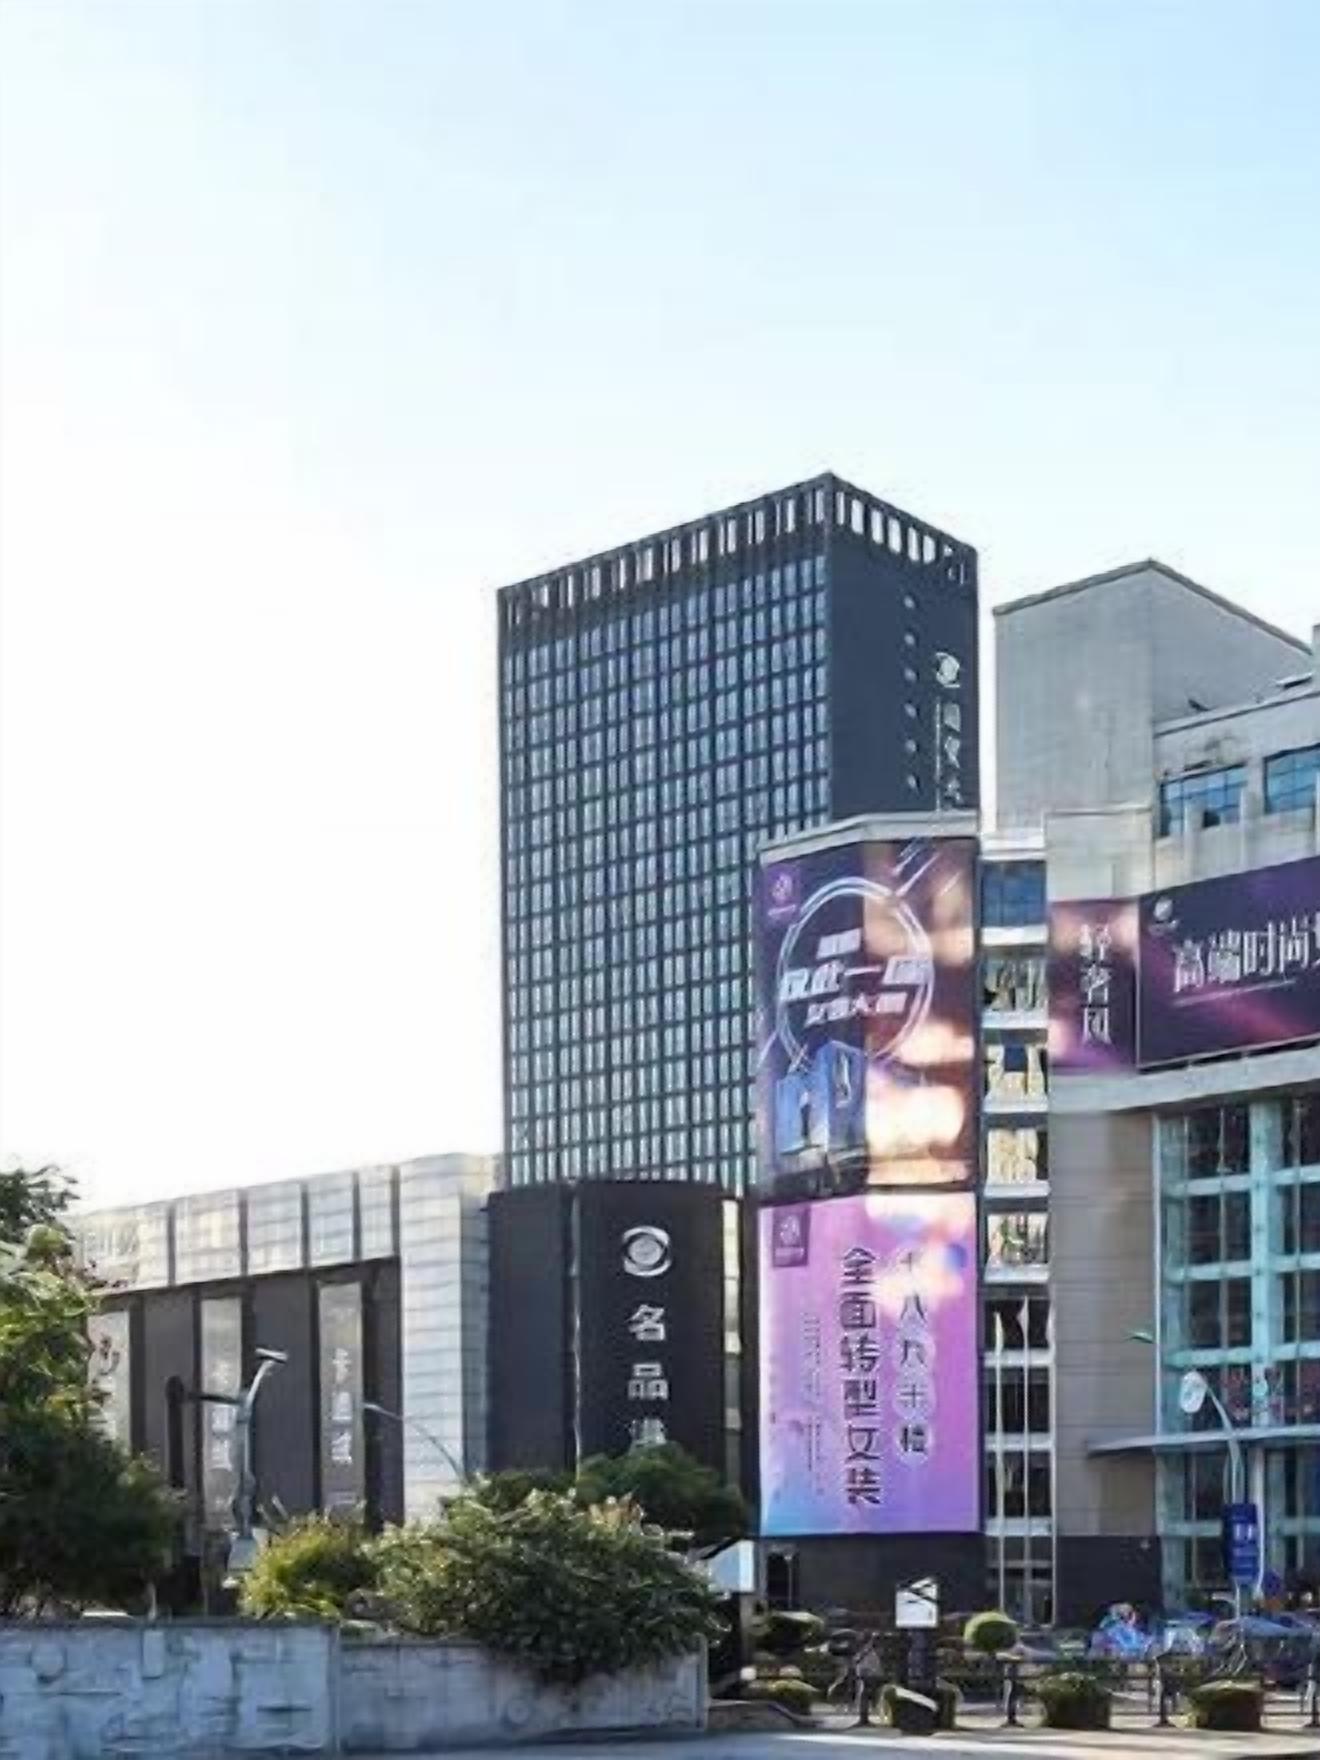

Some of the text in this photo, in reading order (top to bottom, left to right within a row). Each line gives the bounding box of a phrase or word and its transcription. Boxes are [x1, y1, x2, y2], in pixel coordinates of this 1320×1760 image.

[839, 1246, 882, 1506] 全面转型女装
